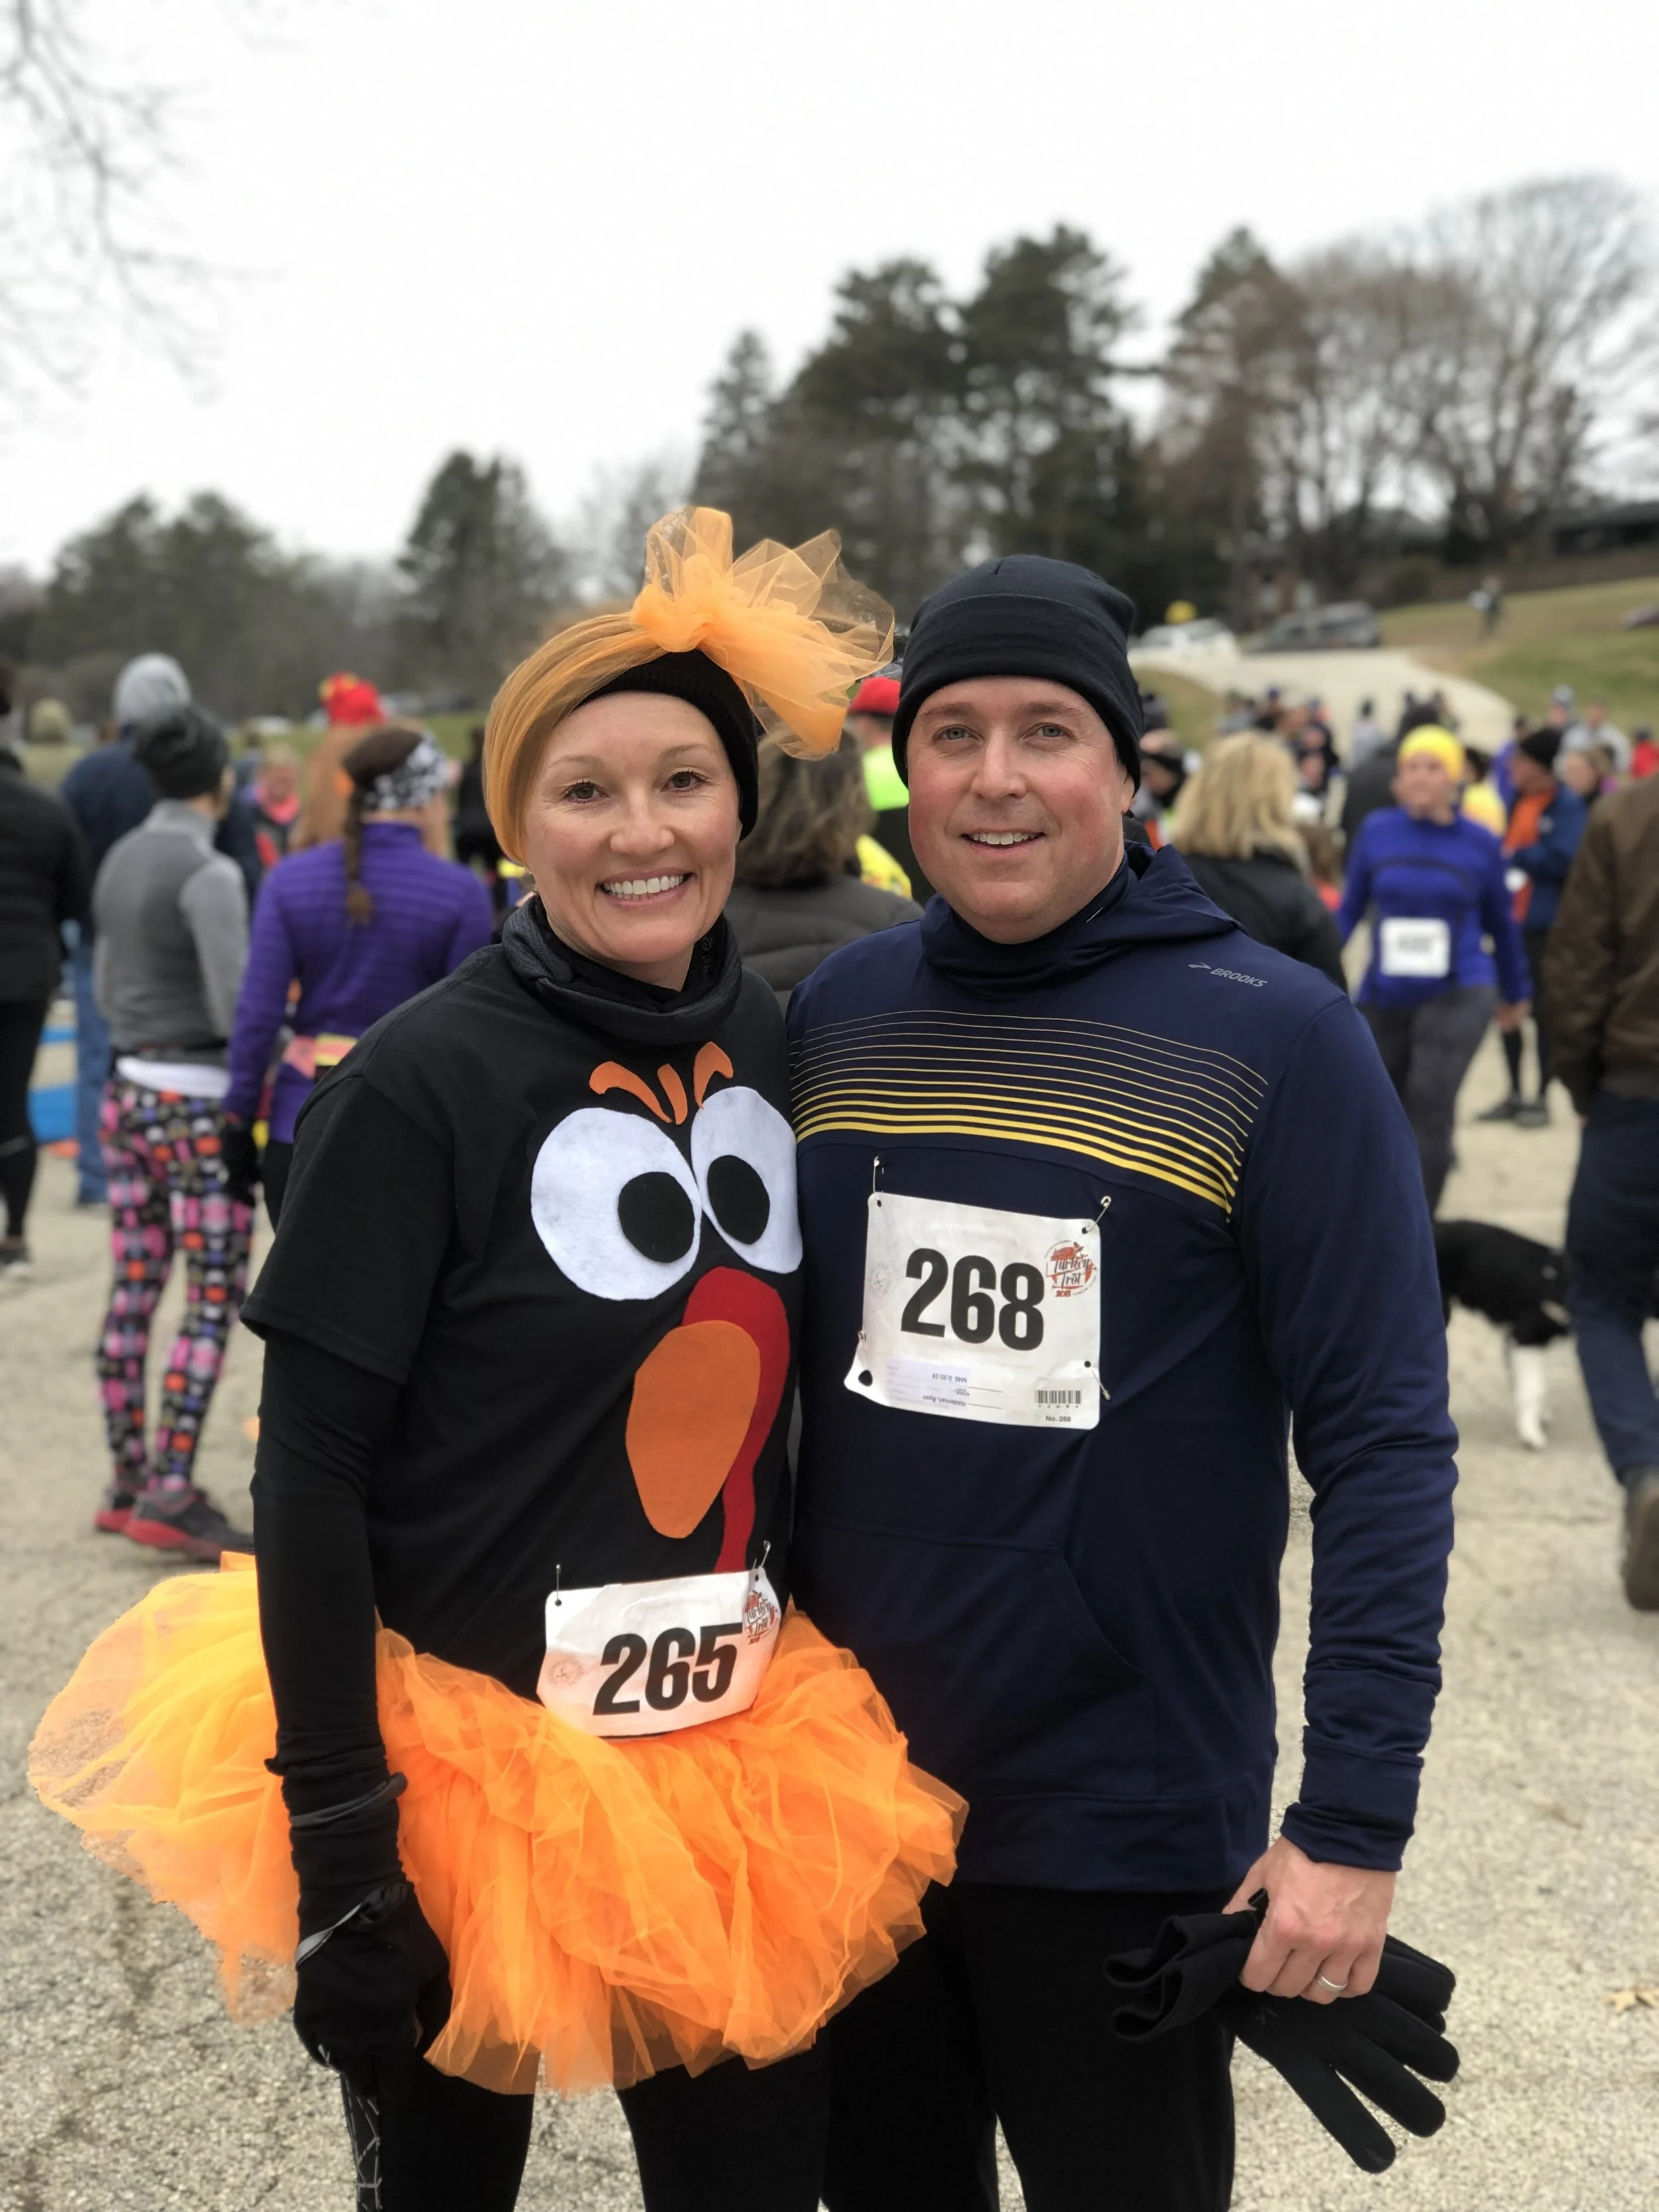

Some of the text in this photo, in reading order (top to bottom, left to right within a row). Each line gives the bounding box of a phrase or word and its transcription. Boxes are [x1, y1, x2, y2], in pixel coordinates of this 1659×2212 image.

[1210, 968, 1268, 987] BROOKS
[1052, 1255, 1090, 1274] Turkey
[1060, 1272, 1082, 1290] Trot
[901, 1248, 1045, 1351] 268
[593, 1622, 743, 1716] 265
